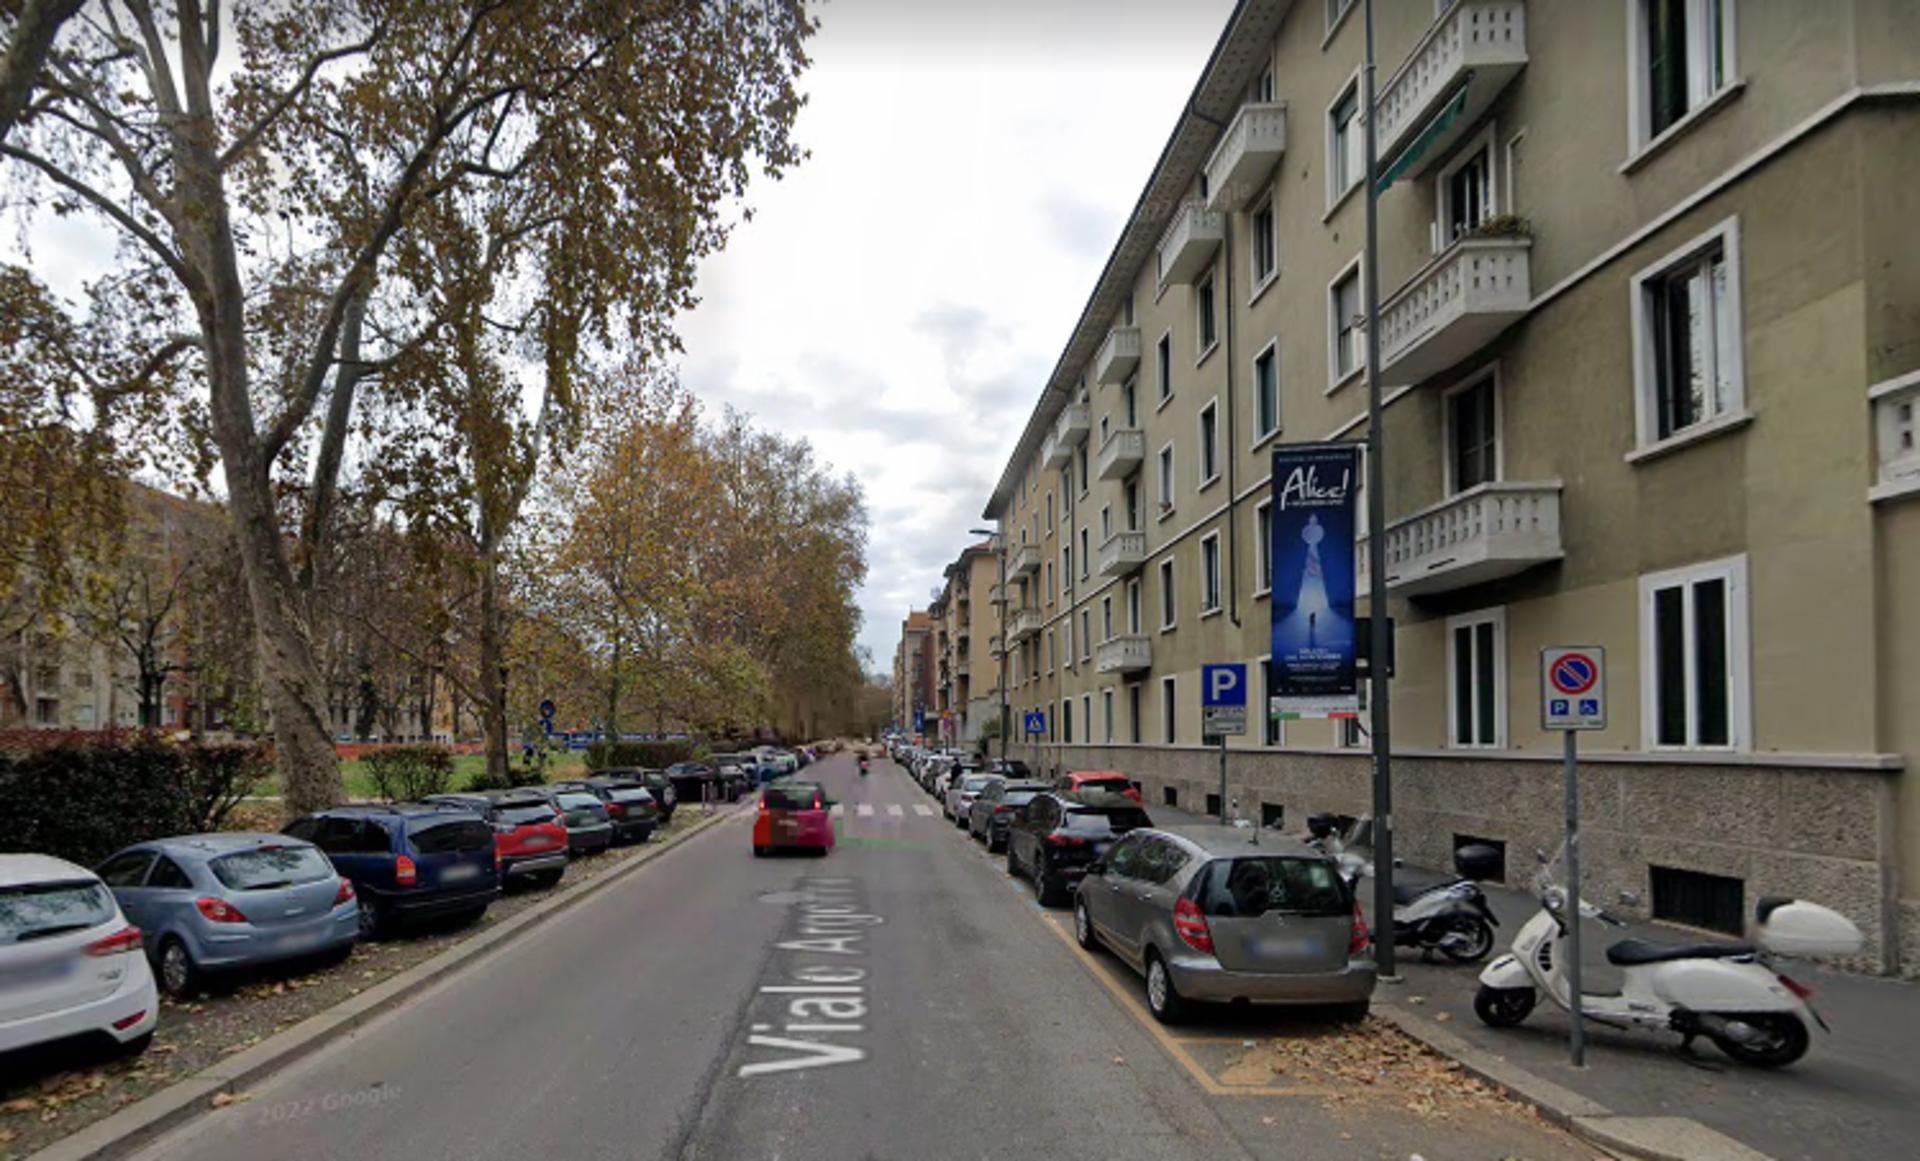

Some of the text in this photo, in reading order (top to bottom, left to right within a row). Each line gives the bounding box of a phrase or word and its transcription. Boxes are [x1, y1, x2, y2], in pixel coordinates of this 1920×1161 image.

[1280, 465, 1349, 511] Alice!
[1212, 669, 1237, 701] P
[1554, 702, 1565, 713] P
